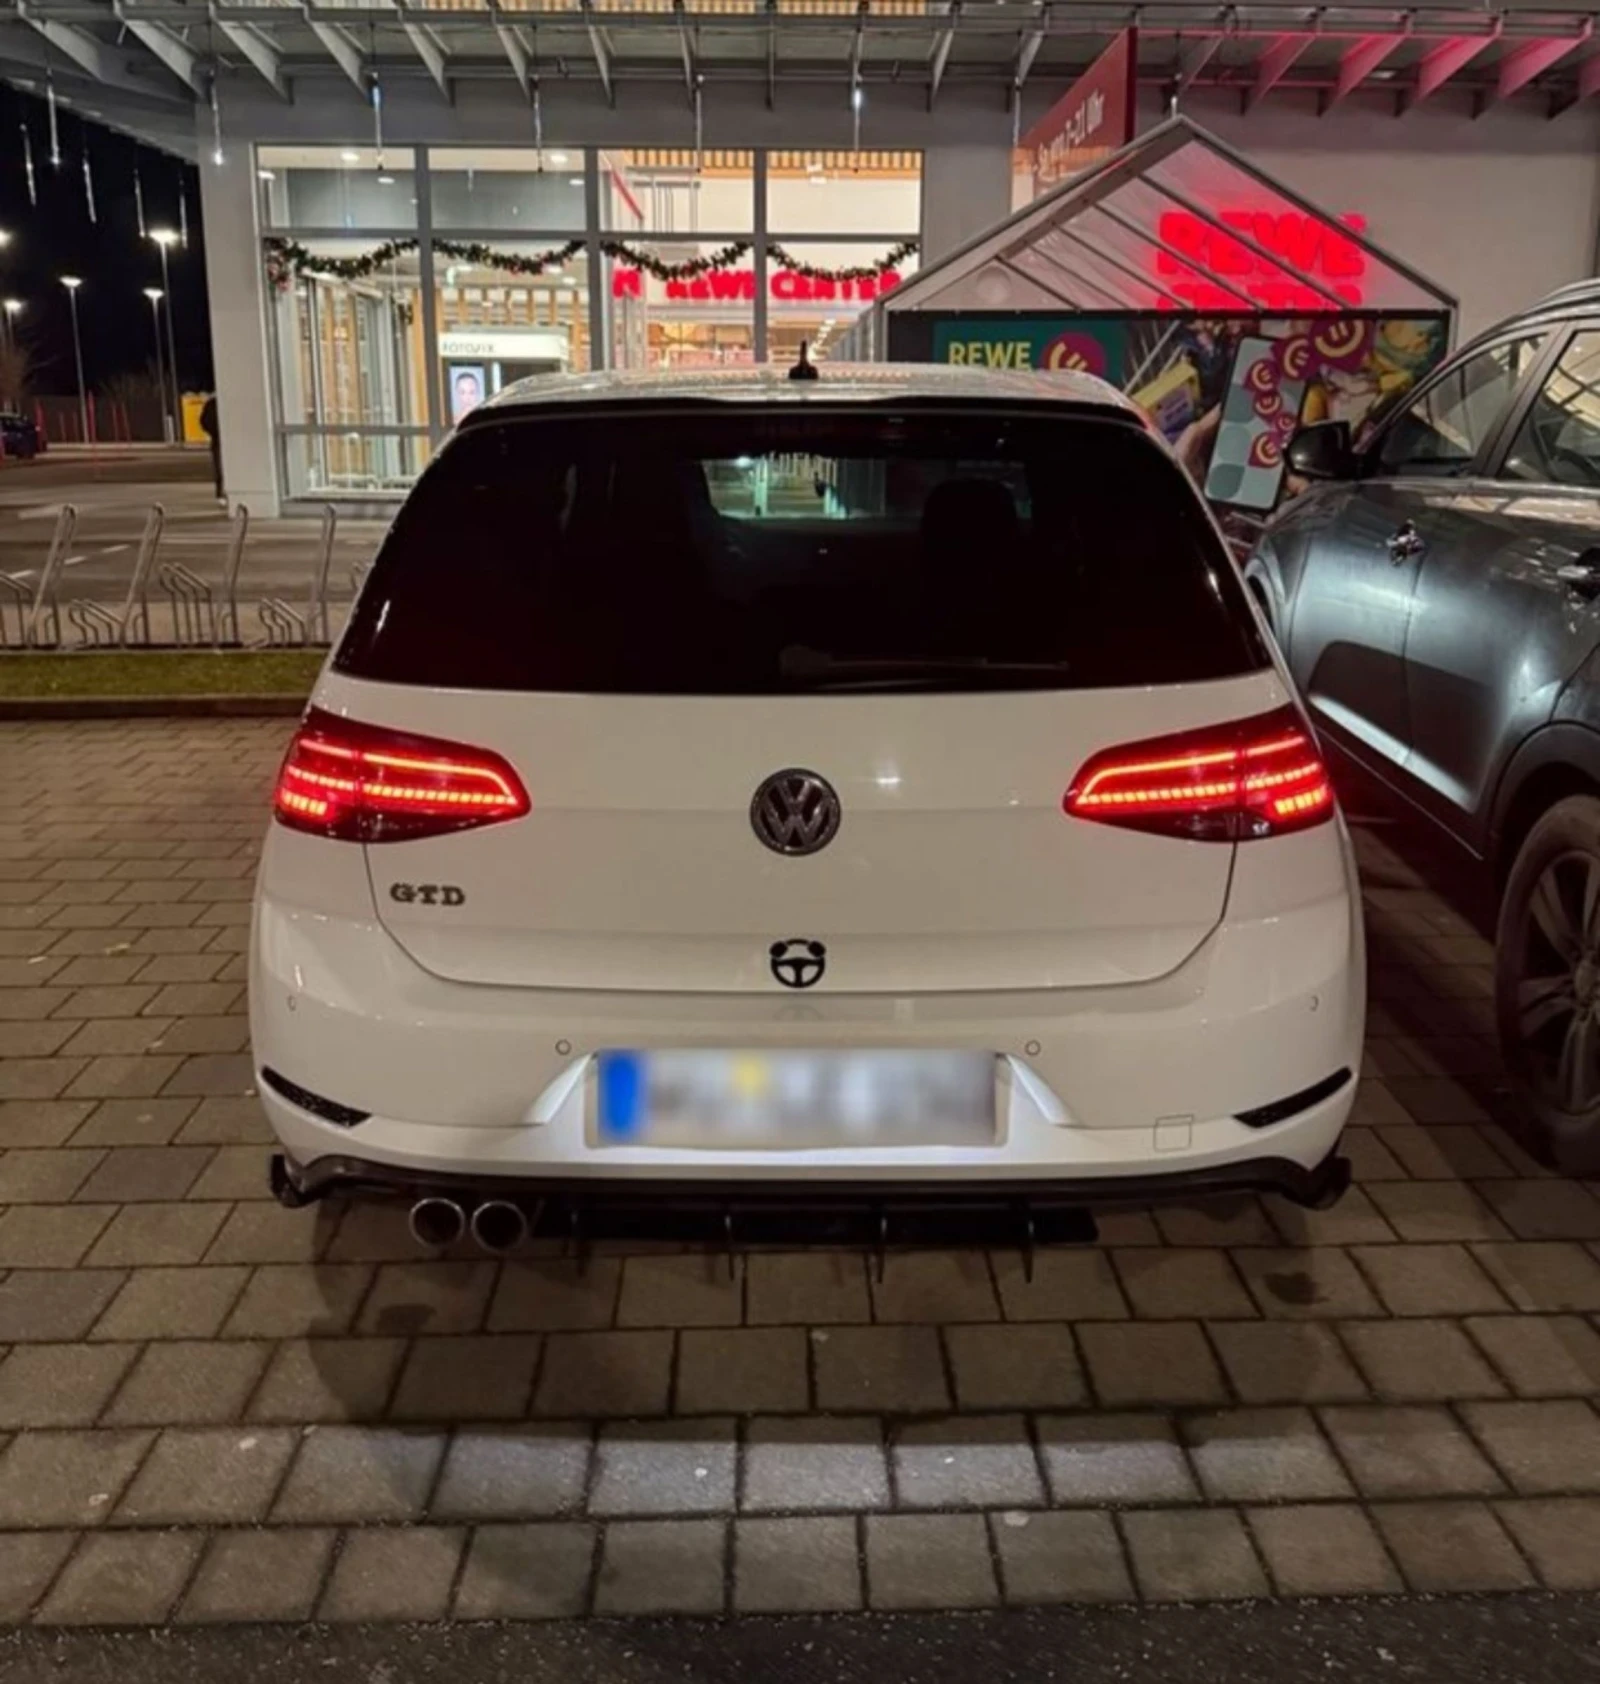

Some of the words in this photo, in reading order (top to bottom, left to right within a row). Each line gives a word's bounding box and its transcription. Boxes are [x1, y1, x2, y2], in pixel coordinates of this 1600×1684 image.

[1158, 211, 1366, 276] REWE
[949, 341, 1032, 370] REWE
[390, 882, 466, 906] GTD
